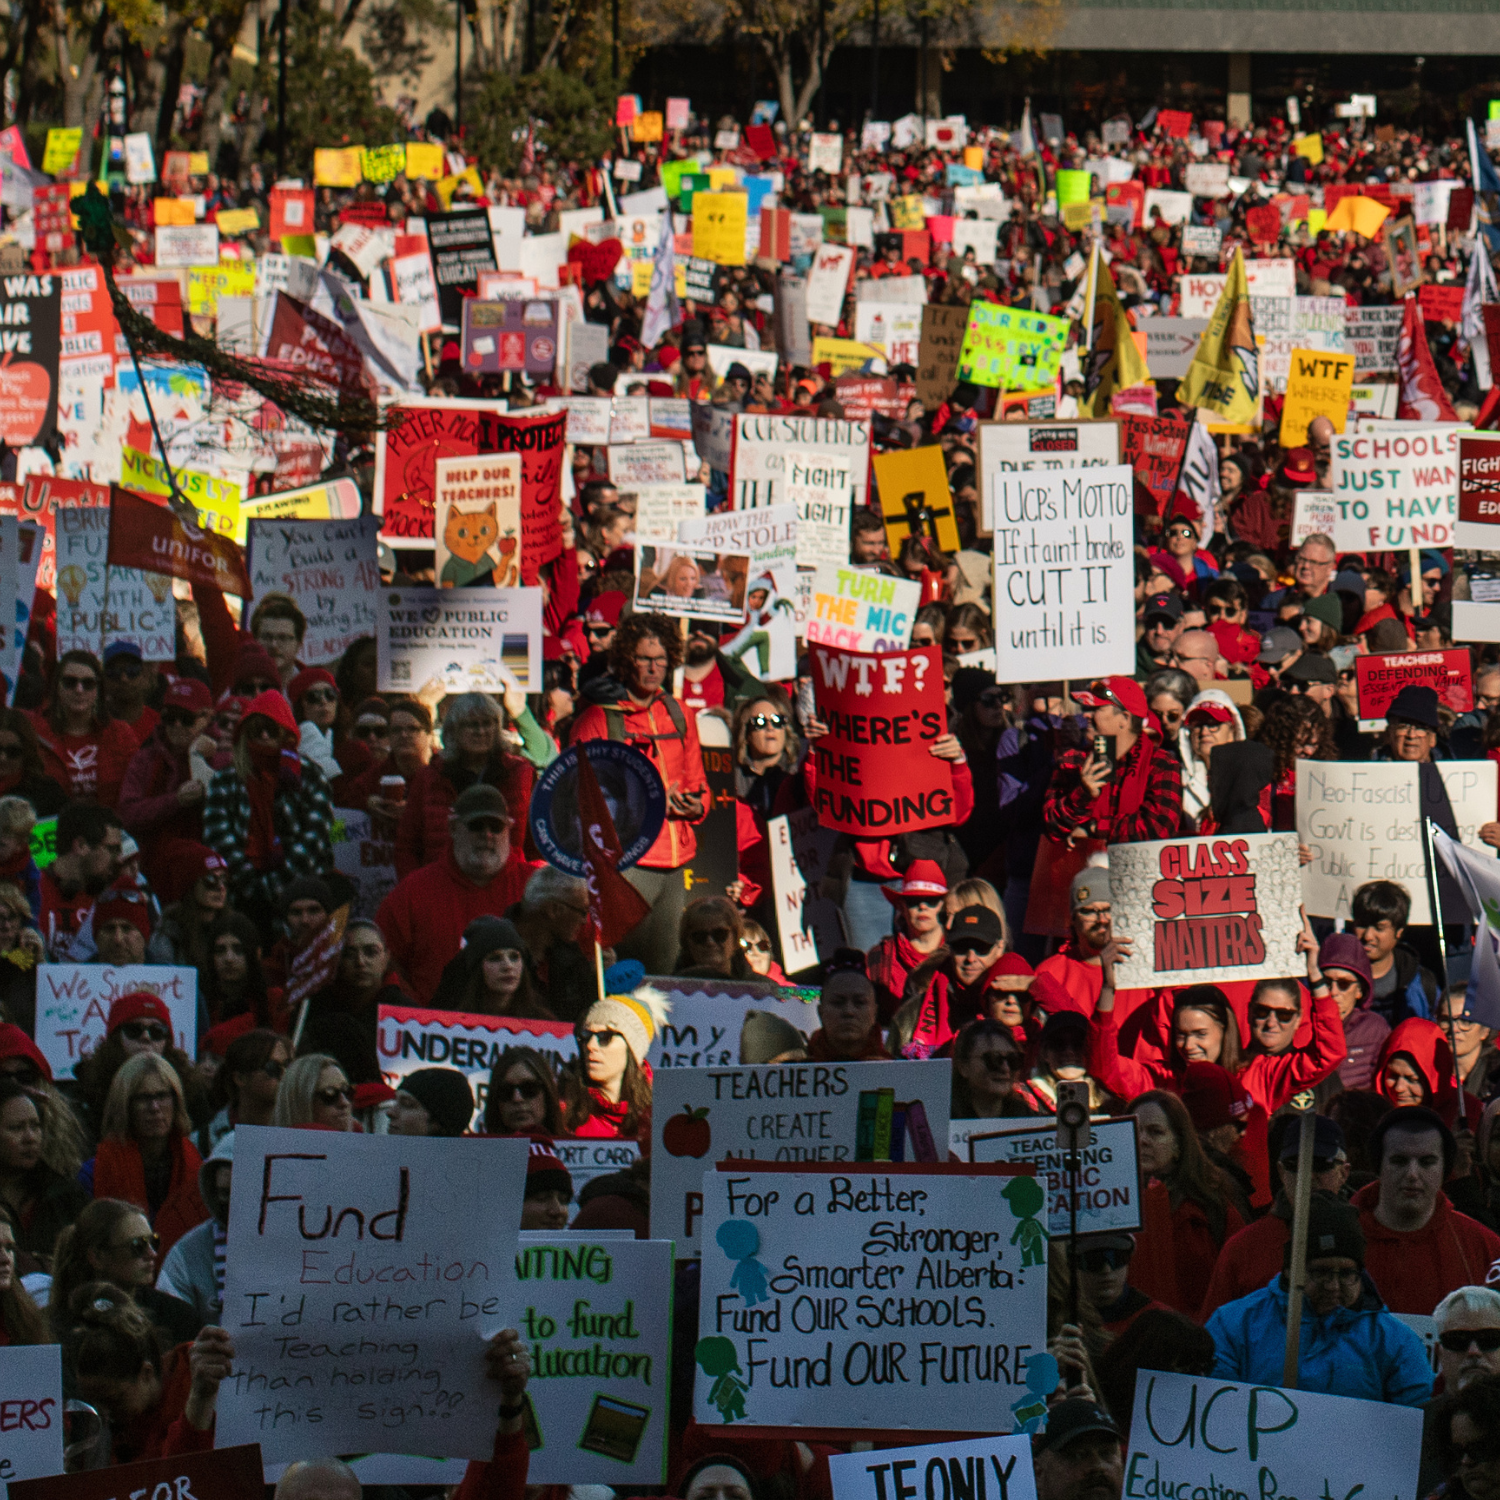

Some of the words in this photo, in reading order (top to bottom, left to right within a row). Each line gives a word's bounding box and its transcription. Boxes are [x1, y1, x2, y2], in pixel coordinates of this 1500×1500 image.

[4, 275, 53, 298] WAS
[1298, 357, 1349, 380] WTF
[497, 416, 567, 452] PROTECT
[1031, 441, 1076, 451] CLOSED
[1337, 432, 1456, 460] SCHOOLS
[446, 470, 478, 483] HELP
[484, 467, 511, 482] OUR
[1337, 469, 1401, 492] JUST
[441, 485, 515, 503] TEACHERS!
[1337, 500, 1369, 520] TO
[1386, 495, 1456, 518] HAVE
[730, 520, 797, 550] STOLE
[745, 510, 774, 525] THE
[1085, 523, 1125, 561] broke
[836, 568, 897, 605] TURN
[1007, 568, 1072, 607] CUT
[1081, 565, 1112, 604] IT
[388, 610, 420, 624] WE
[444, 609, 510, 624] PUBLIC
[814, 592, 858, 626] THE
[866, 606, 907, 636] MIC
[1012, 613, 1064, 649] until
[388, 625, 493, 640] EDUCATION
[816, 649, 930, 698] WTF?
[1382, 652, 1445, 668] TEACHERS
[816, 705, 942, 746] WHERE'S
[816, 747, 863, 786] THE
[1307, 771, 1414, 804] Neo-Fascist
[817, 788, 953, 828] FUNDING
[1159, 838, 1250, 880] CLASS
[1151, 873, 1257, 919] SIZE
[1154, 912, 1267, 973] MATTERS
[708, 1066, 849, 1101] TEACHERS
[747, 1111, 833, 1141] CREATE
[593, 1146, 635, 1166] CARD
[257, 1152, 410, 1242] Fund
[727, 1177, 779, 1217] For
[828, 1177, 928, 1217] Better,
[861, 1220, 1003, 1262] Stronger,
[299, 1249, 490, 1285] Education
[769, 1255, 905, 1294] Smarter
[915, 1257, 1026, 1291] Alberta:
[240, 1292, 306, 1328] I'd
[333, 1295, 447, 1322] rather
[459, 1291, 500, 1320] be
[519, 1306, 558, 1340] to
[566, 1298, 640, 1341] fund
[716, 1294, 781, 1333] Fund
[792, 1295, 850, 1334] OUR
[856, 1295, 996, 1329] SCHOOLS.
[273, 1336, 419, 1366] Teaching
[746, 1338, 833, 1389] Fund
[843, 1341, 910, 1387] OUR
[920, 1341, 1033, 1387] FUTURE
[228, 1365, 314, 1396] than
[330, 1366, 441, 1395] holding
[253, 1402, 325, 1431] this
[1145, 1375, 1299, 1462] UCP
[1126, 1451, 1249, 1500] Education
